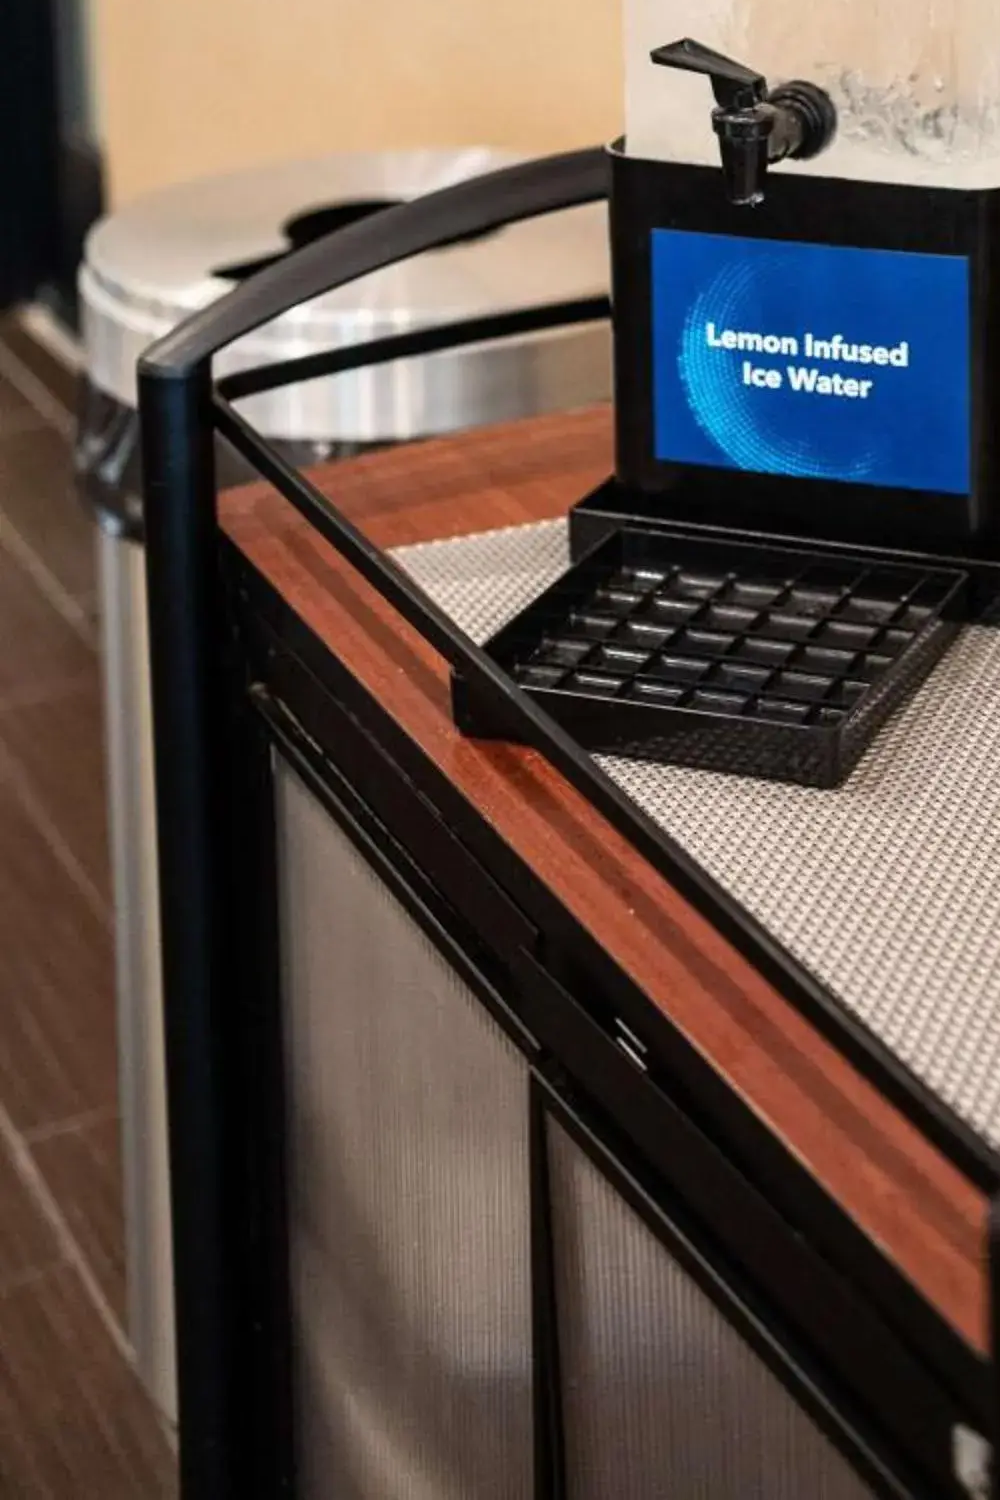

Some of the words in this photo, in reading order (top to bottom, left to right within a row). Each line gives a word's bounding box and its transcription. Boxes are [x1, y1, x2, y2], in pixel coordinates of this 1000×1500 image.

[706, 323, 798, 355] Lemon
[804, 333, 909, 367] Infused
[743, 362, 782, 388] Ice
[787, 367, 873, 398] Water
